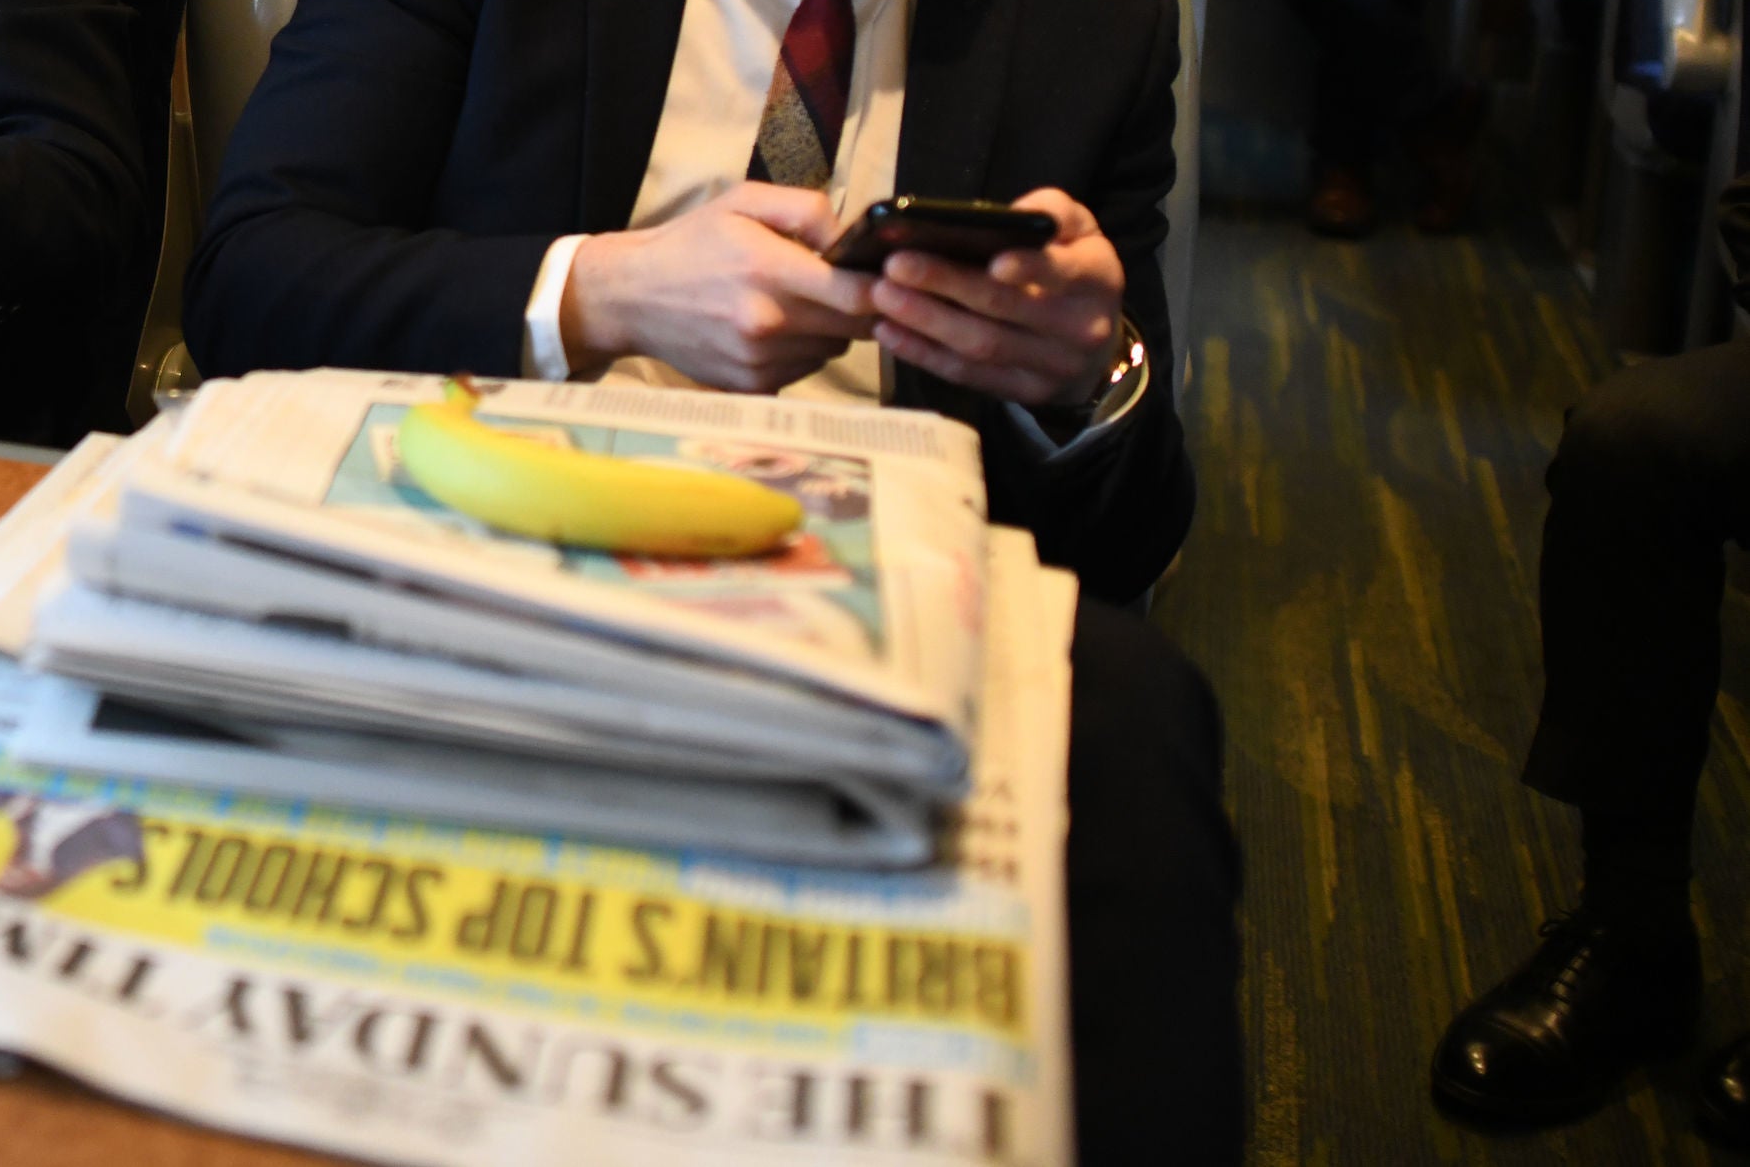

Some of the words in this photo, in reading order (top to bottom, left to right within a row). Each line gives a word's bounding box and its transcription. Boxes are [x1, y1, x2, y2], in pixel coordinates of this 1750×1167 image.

[110, 822, 444, 938] SCHOOLS
[451, 878, 598, 973] TOP
[624, 901, 1024, 1031] BRITAIN'S
[202, 974, 725, 1124] SUNDAY
[750, 1071, 1022, 1159] THE
